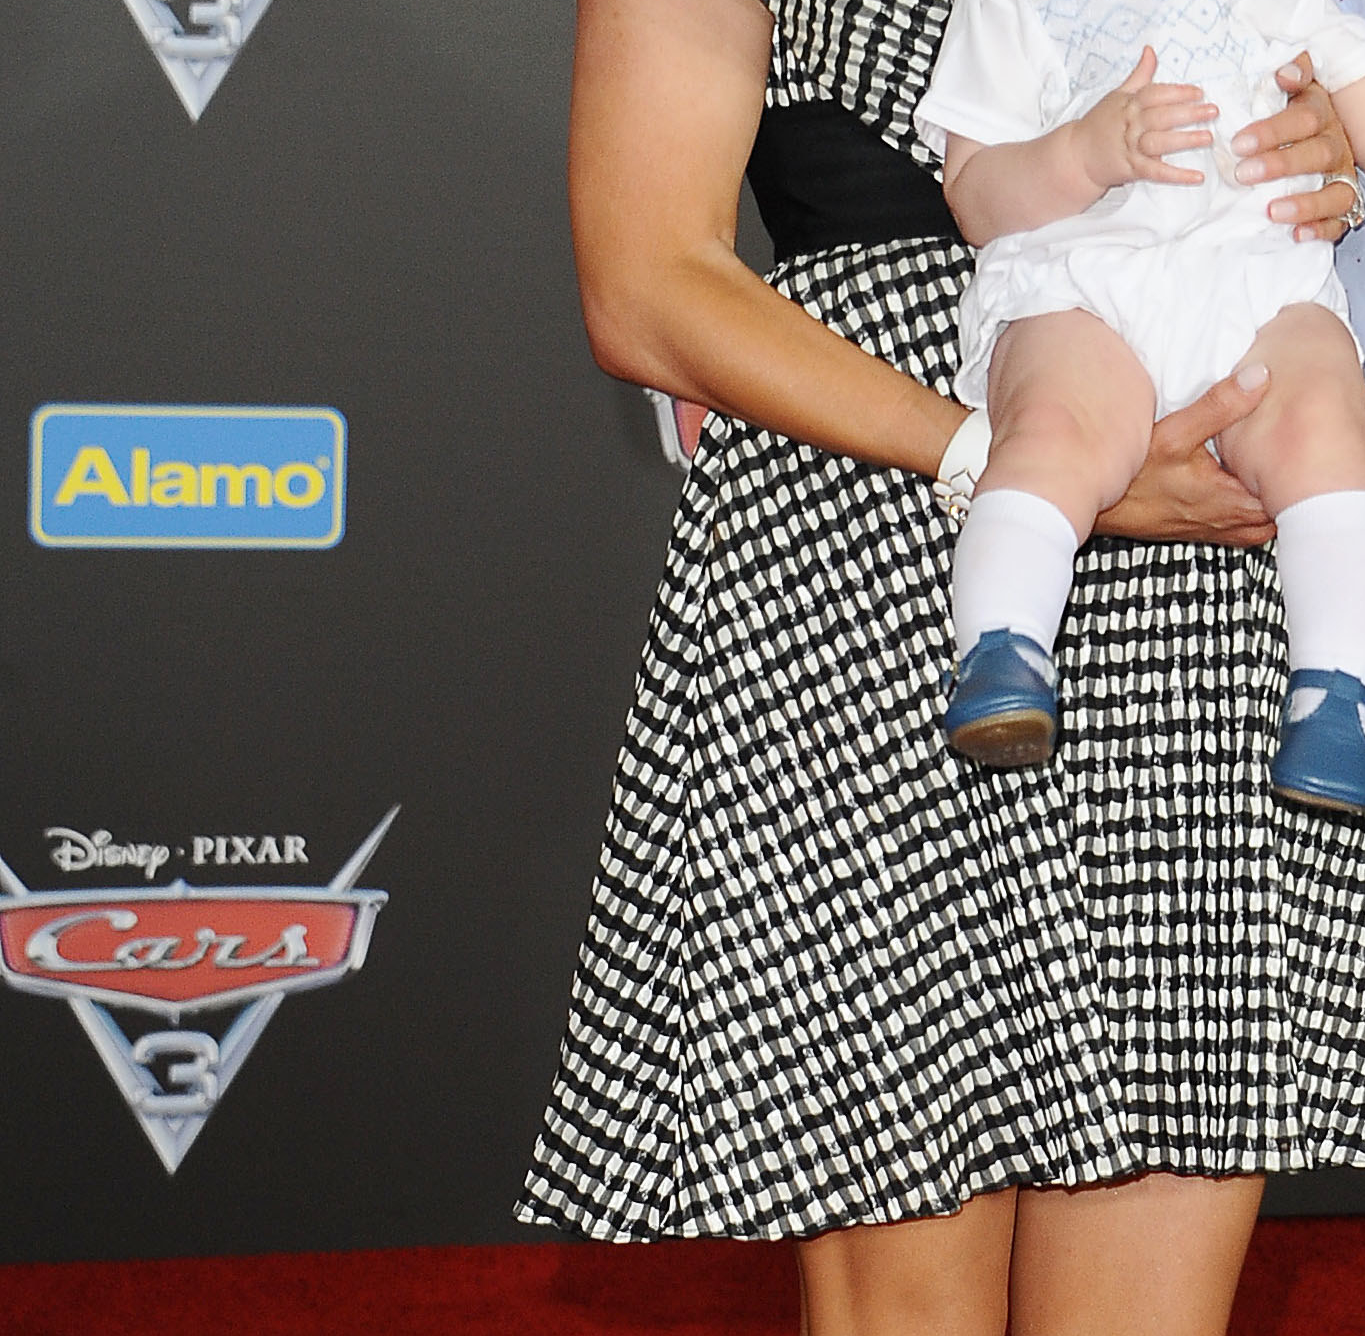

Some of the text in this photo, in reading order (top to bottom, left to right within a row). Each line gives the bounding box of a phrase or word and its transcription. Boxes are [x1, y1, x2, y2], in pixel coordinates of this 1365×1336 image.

[54, 447, 325, 508] Alamo
[45, 827, 309, 879] Disney PIXAR
[25, 909, 320, 971] Cars
[133, 1030, 219, 1115] 3
